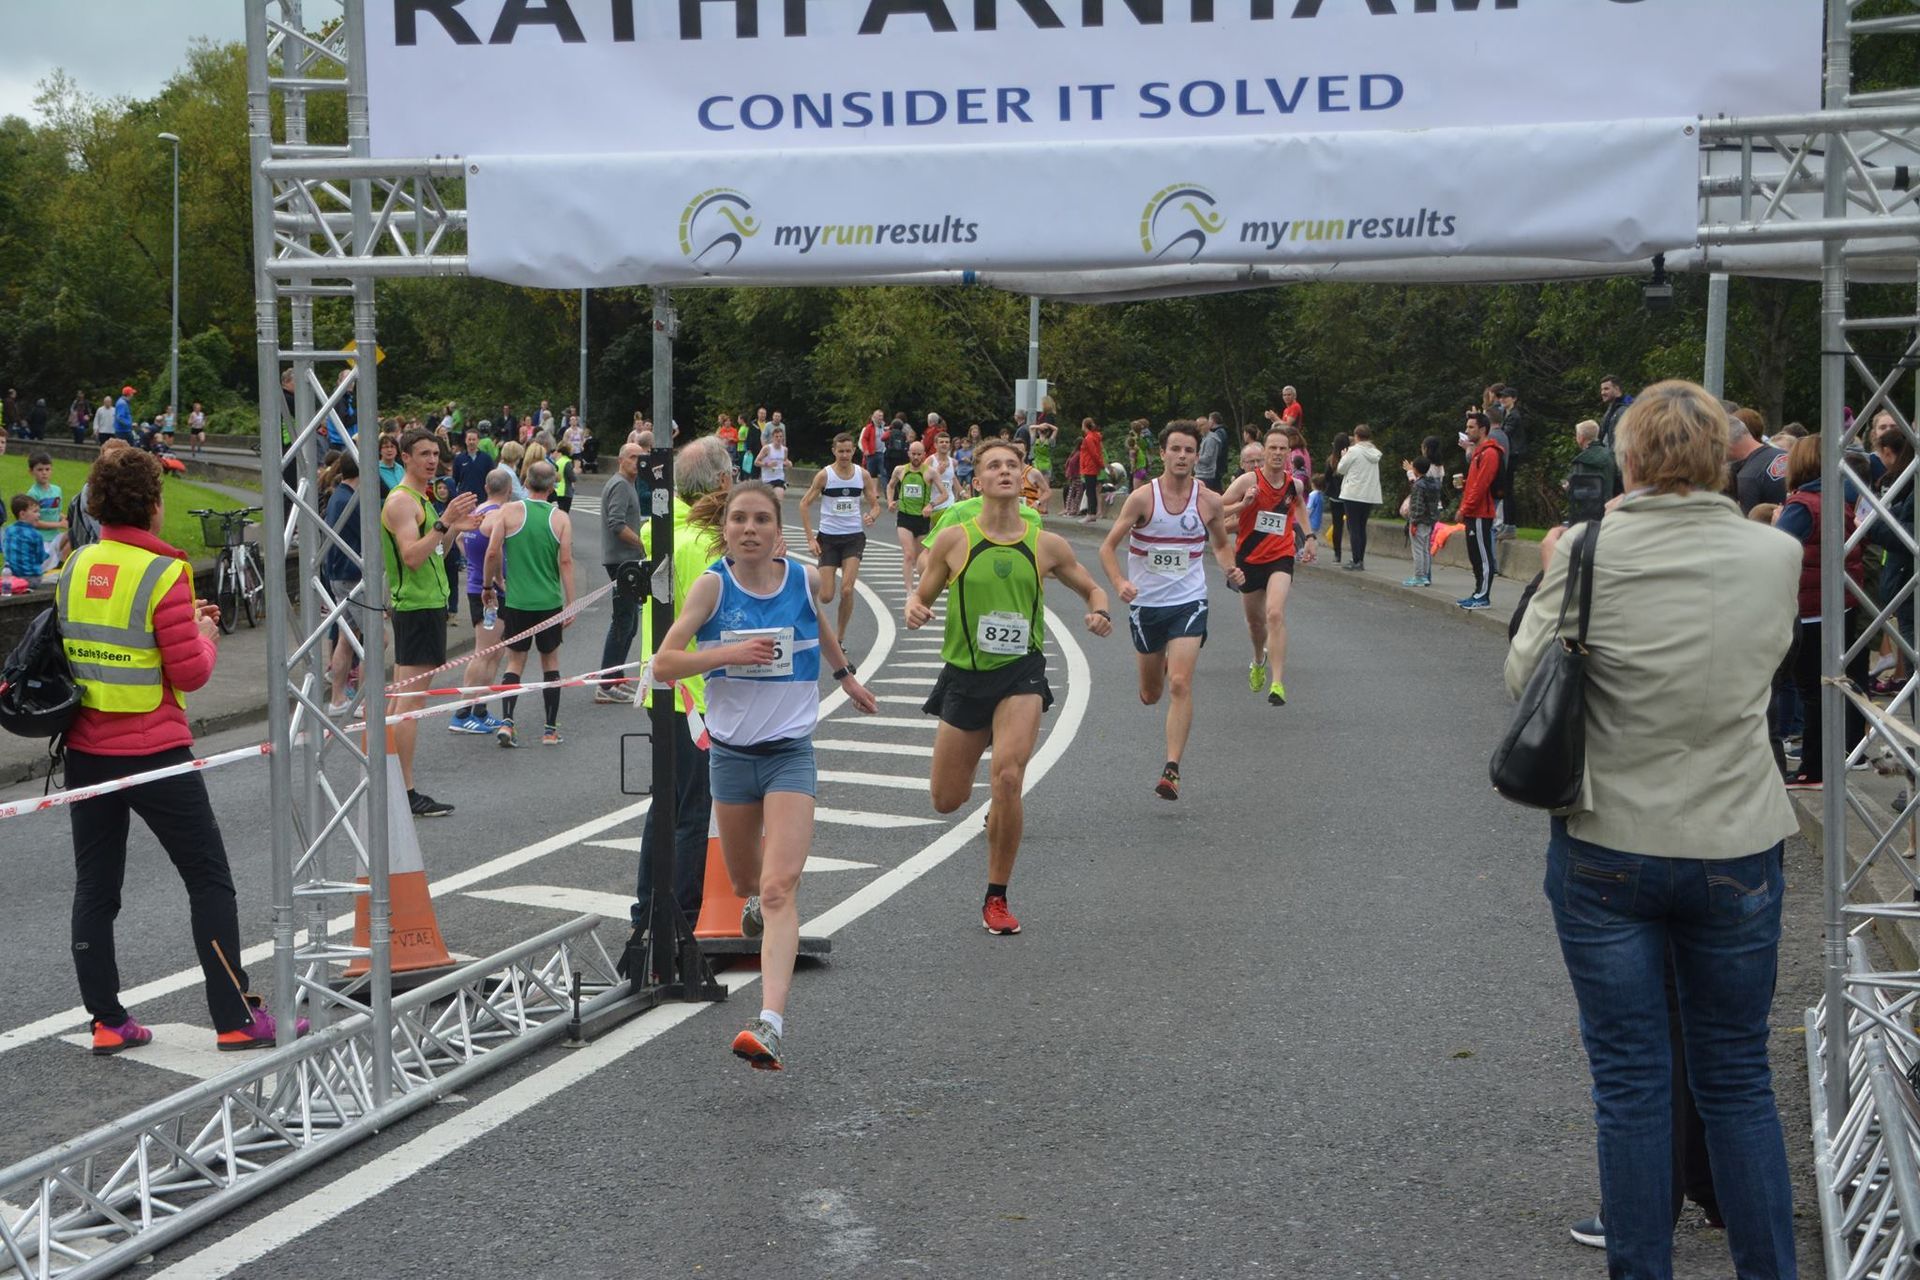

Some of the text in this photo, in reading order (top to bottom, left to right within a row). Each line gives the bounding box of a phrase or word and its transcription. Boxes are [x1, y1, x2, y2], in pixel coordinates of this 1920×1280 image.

[698, 74, 1404, 131] CONSIDER IT SOLVED
[774, 215, 979, 254] myrunresults
[1239, 208, 1456, 250] myrunresults
[1260, 516, 1281, 528] 321
[1153, 554, 1181, 567] 891
[89, 575, 109, 586] RSA
[985, 626, 1022, 643] 822
[103, 651, 131, 661] Seen
